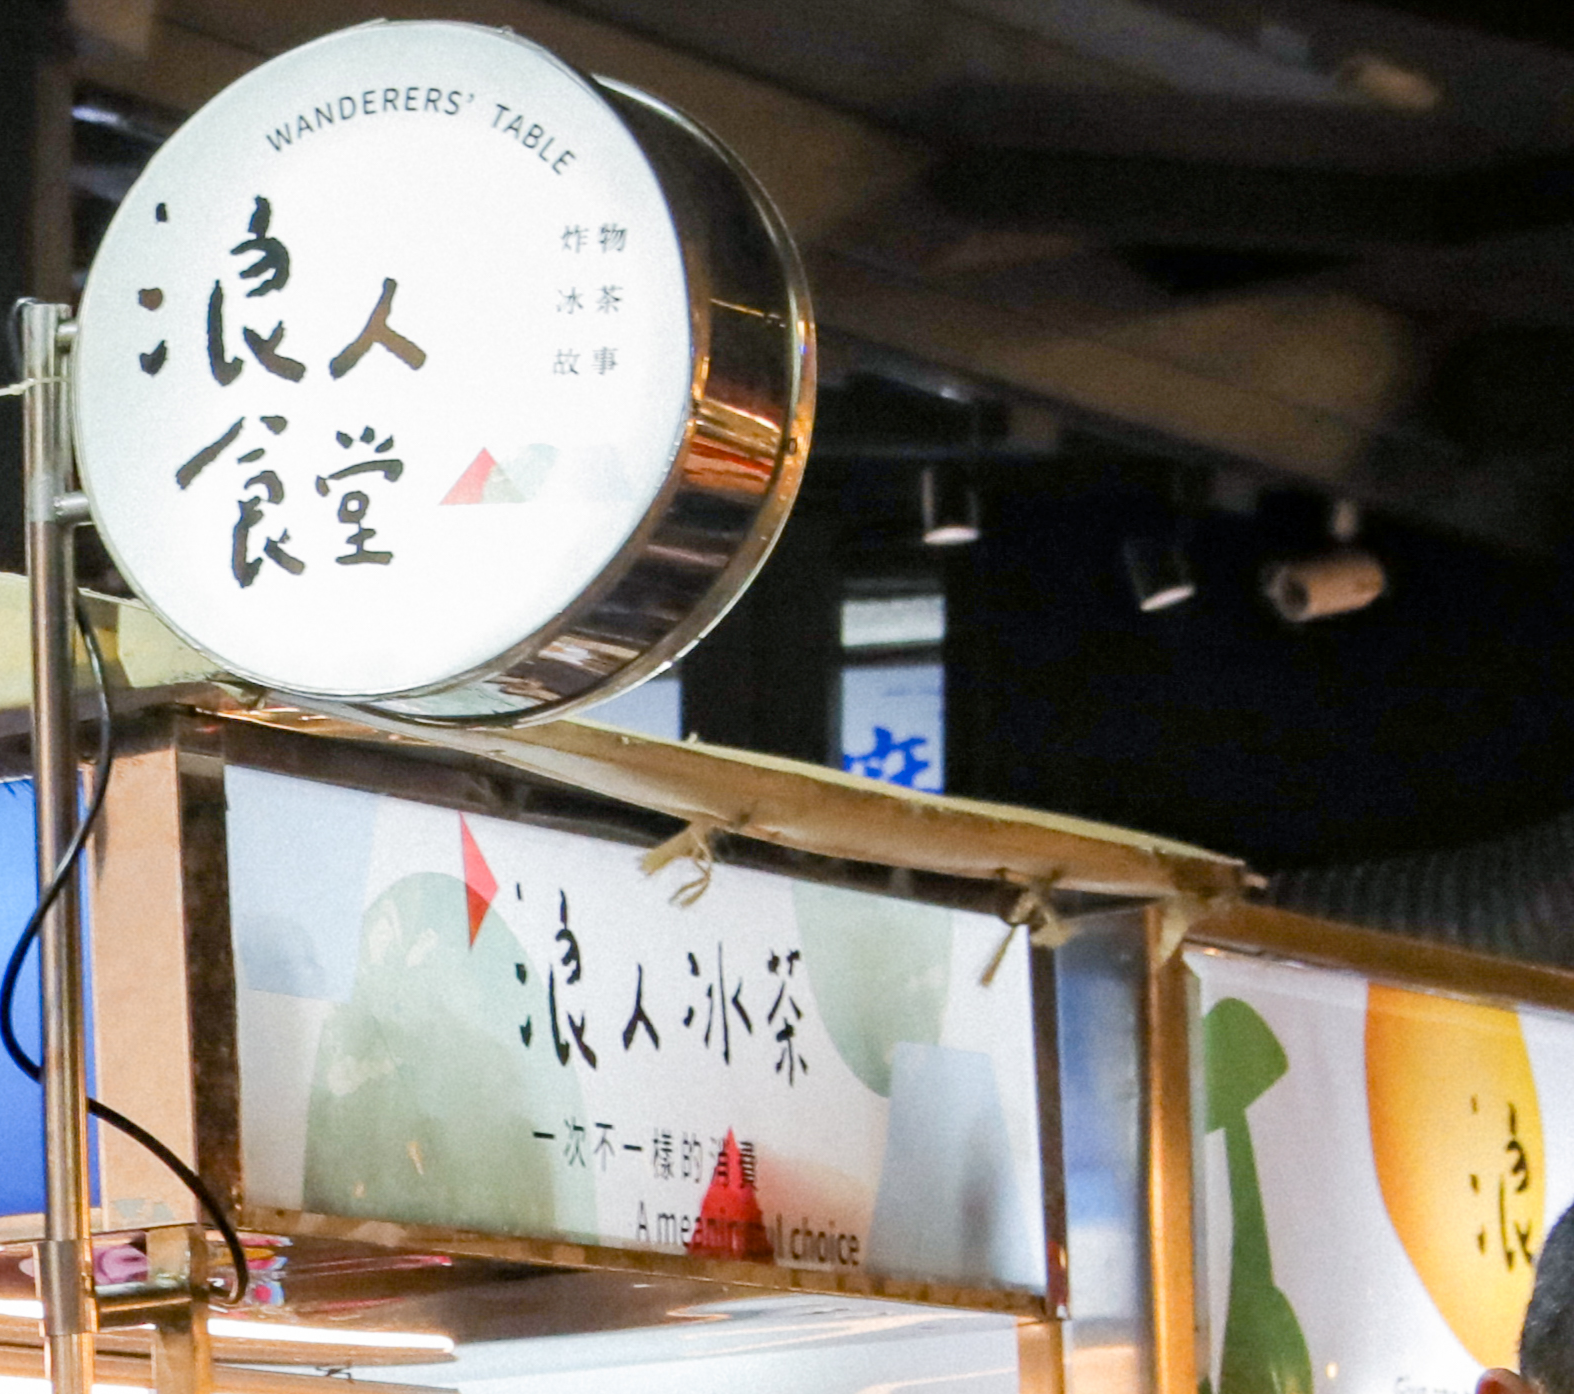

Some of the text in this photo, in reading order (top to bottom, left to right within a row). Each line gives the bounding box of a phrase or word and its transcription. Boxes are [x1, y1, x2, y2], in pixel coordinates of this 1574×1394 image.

[265, 86, 577, 175] WANDERERS' TABLE
[560, 222, 628, 255] 炸物
[139, 196, 426, 386] 浪人
[555, 284, 625, 315] 冰茶
[551, 347, 619, 377] 故事
[176, 415, 403, 588] 食堂
[515, 882, 808, 1087] 浪人冰茶
[636, 1201, 650, 1244] A
[790, 1216, 860, 1267] choice
